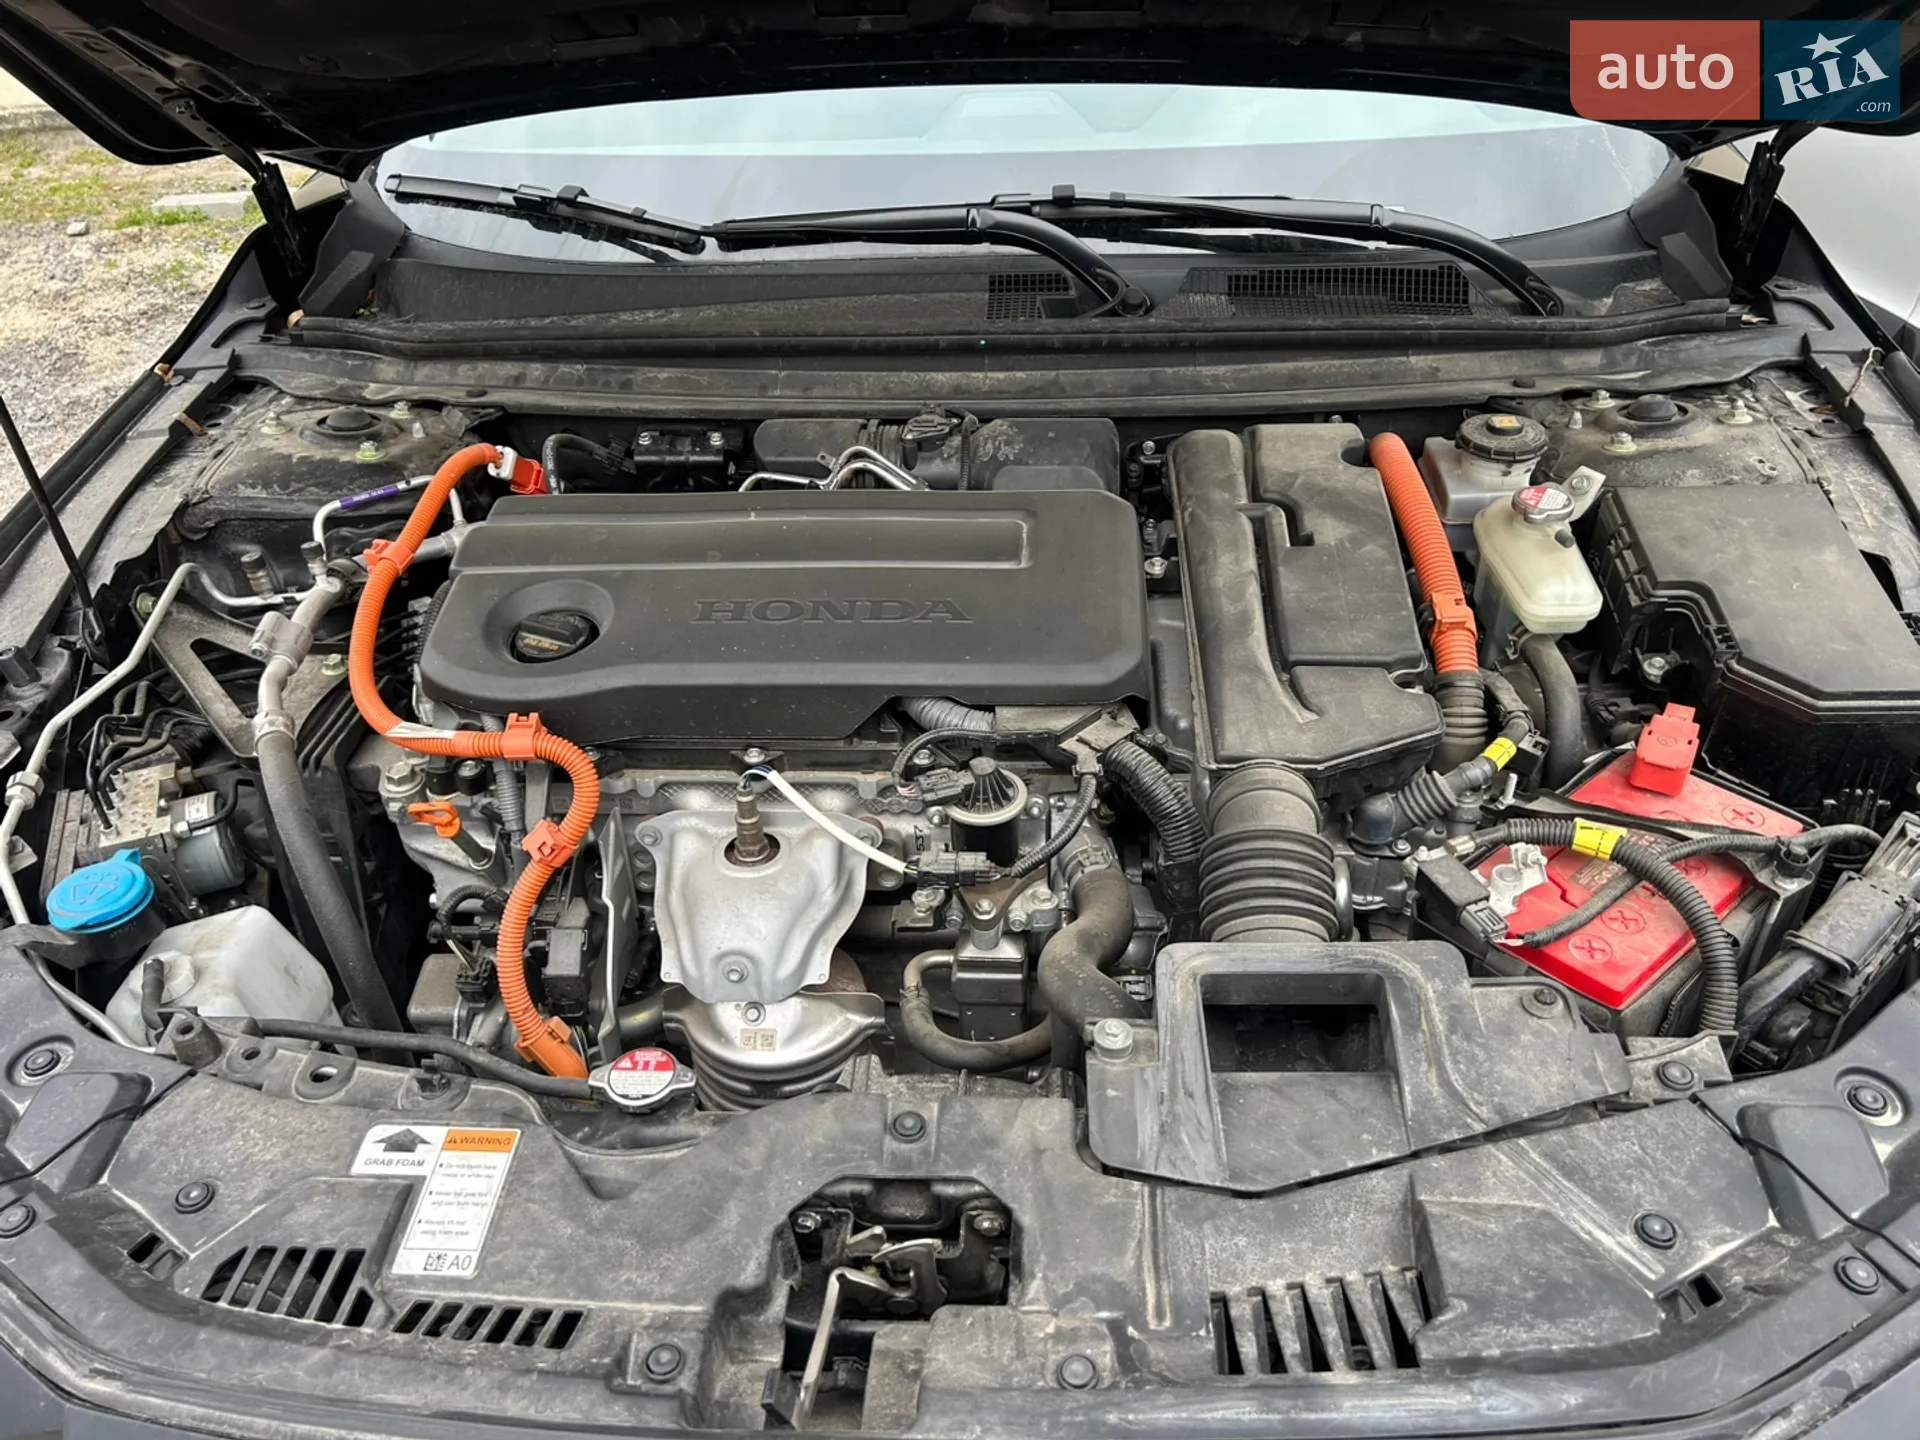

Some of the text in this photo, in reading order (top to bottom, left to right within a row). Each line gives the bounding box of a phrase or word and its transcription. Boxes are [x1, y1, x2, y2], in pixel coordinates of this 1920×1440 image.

[690, 598, 974, 625] HONDA
[460, 1136, 512, 1146] WARNING
[364, 1157, 425, 1167] GRAB FOAM
[447, 1254, 473, 1271] A0
